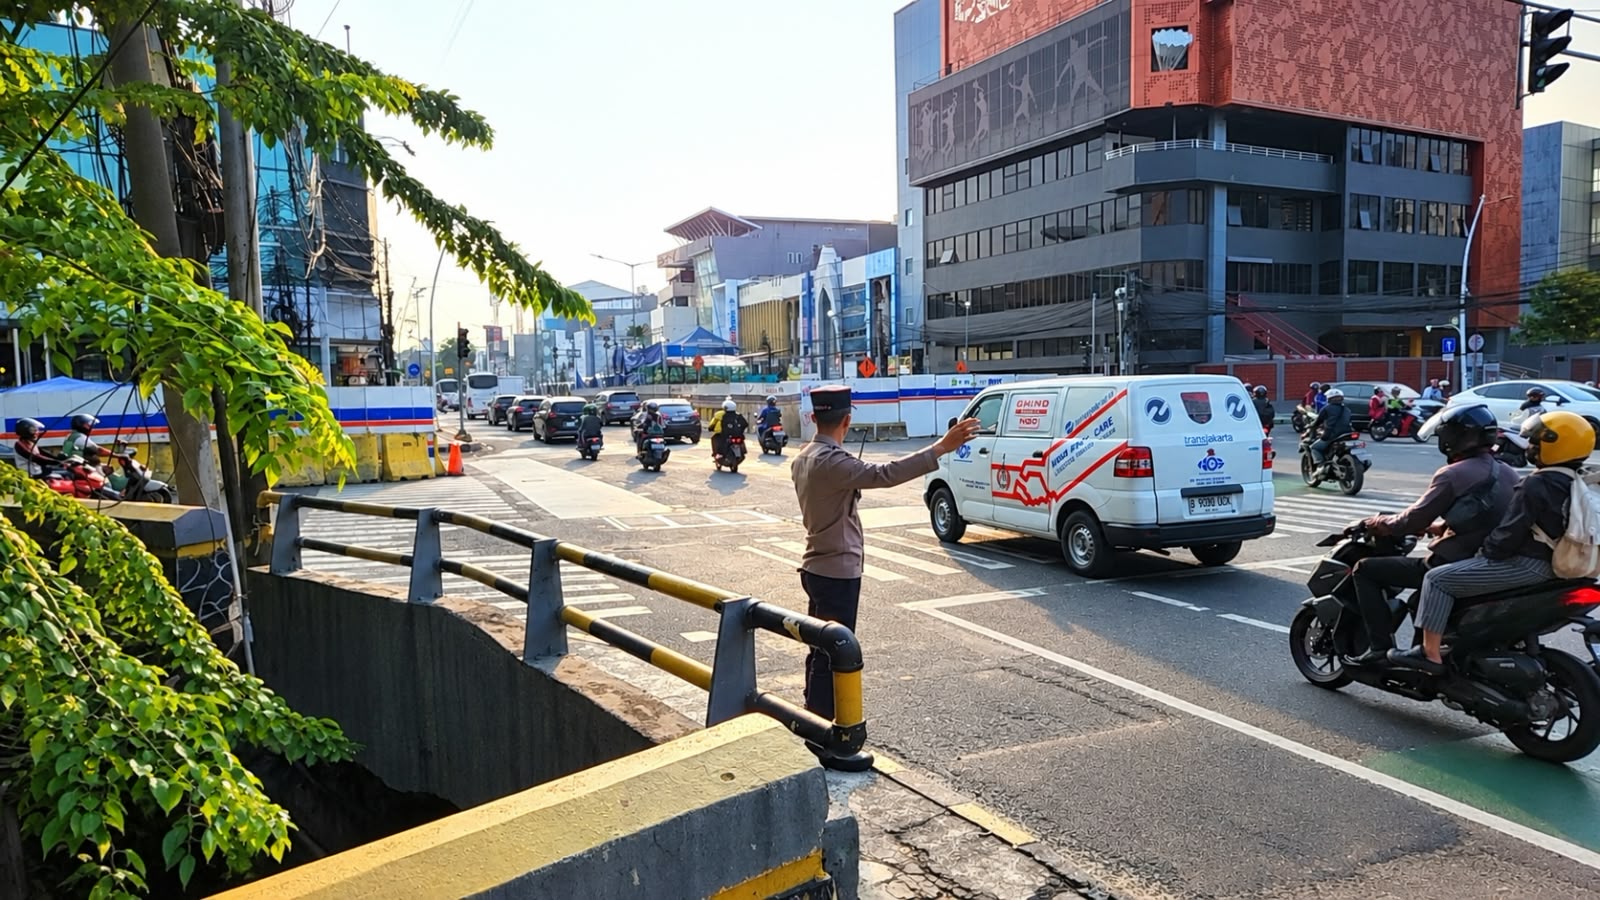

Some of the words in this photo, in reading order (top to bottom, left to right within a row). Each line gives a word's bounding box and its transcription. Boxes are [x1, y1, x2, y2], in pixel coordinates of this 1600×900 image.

[1093, 416, 1114, 437] CARE
[1184, 433, 1234, 445] transjakarta
[1190, 499, 1196, 509] B
